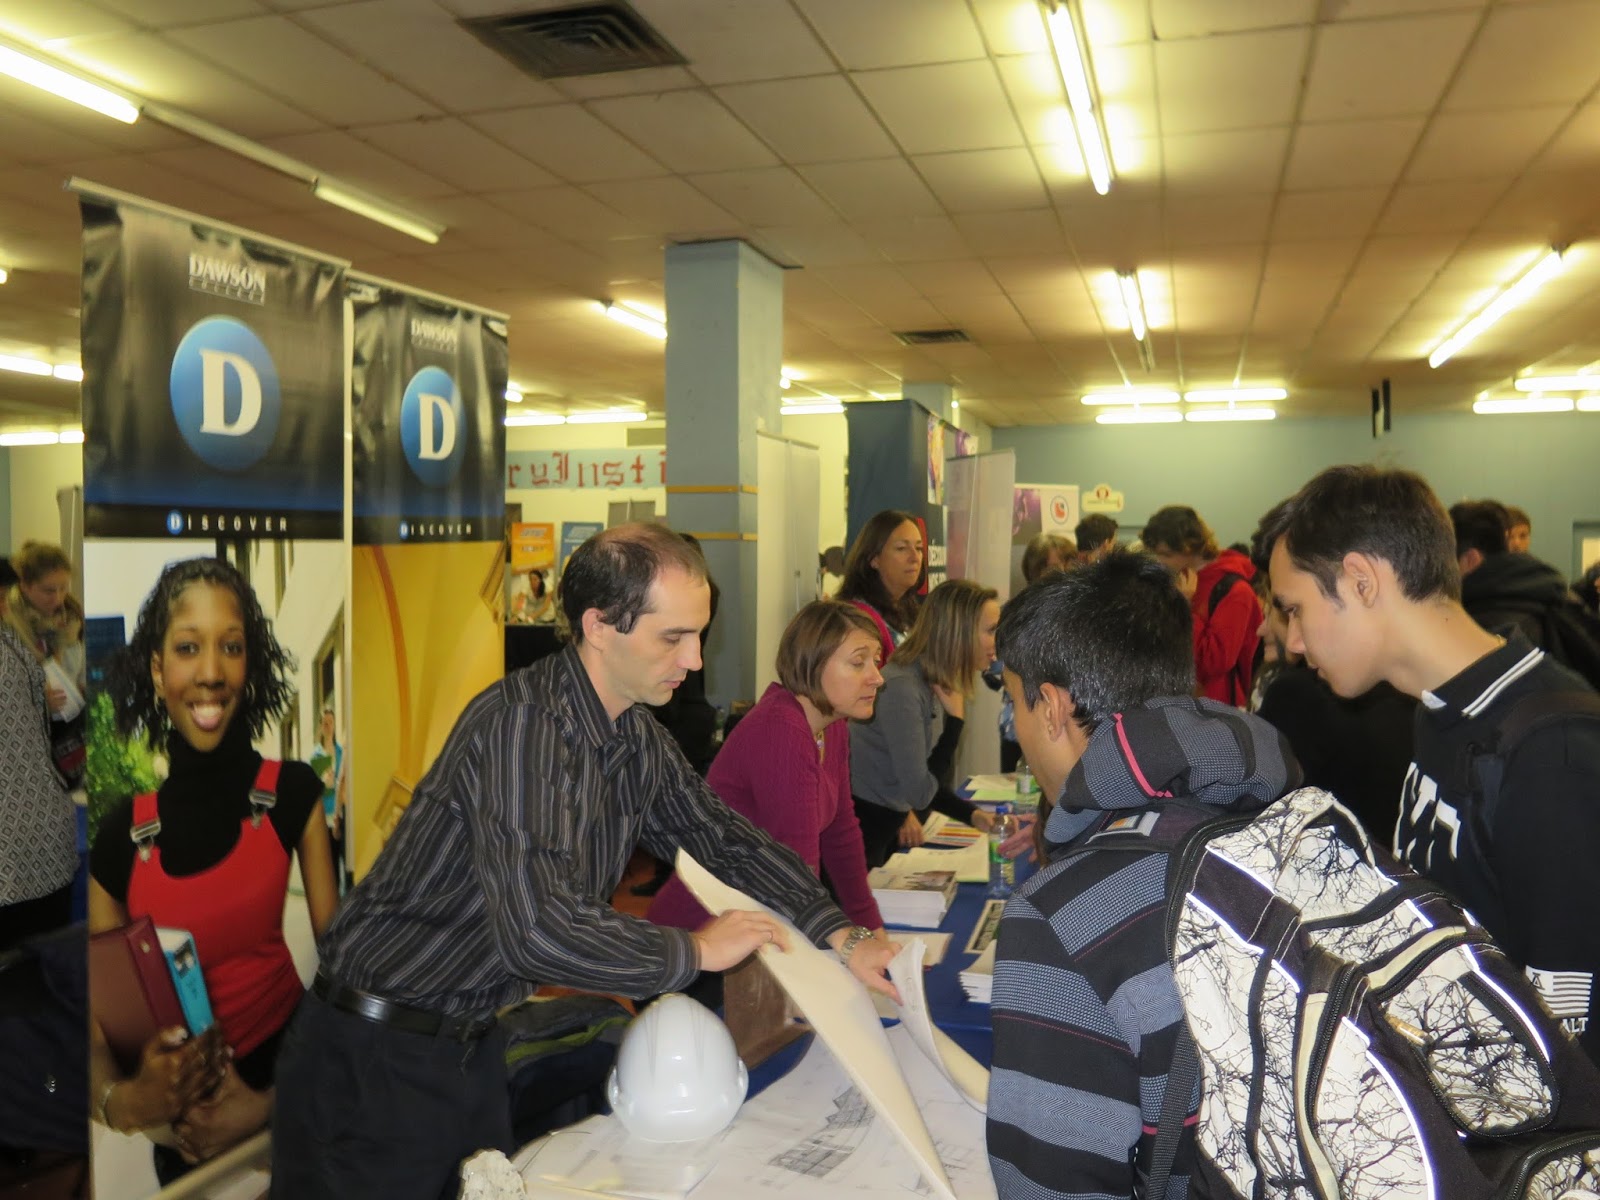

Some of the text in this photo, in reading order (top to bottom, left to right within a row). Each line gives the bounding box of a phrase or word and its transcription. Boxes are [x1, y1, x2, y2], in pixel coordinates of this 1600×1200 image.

[189, 253, 266, 293] DAWSON
[411, 319, 457, 345] DAWSON
[199, 347, 263, 437] D
[417, 392, 457, 461] D
[170, 512, 287, 531] DISCOVER
[400, 522, 472, 537] DISCOVER
